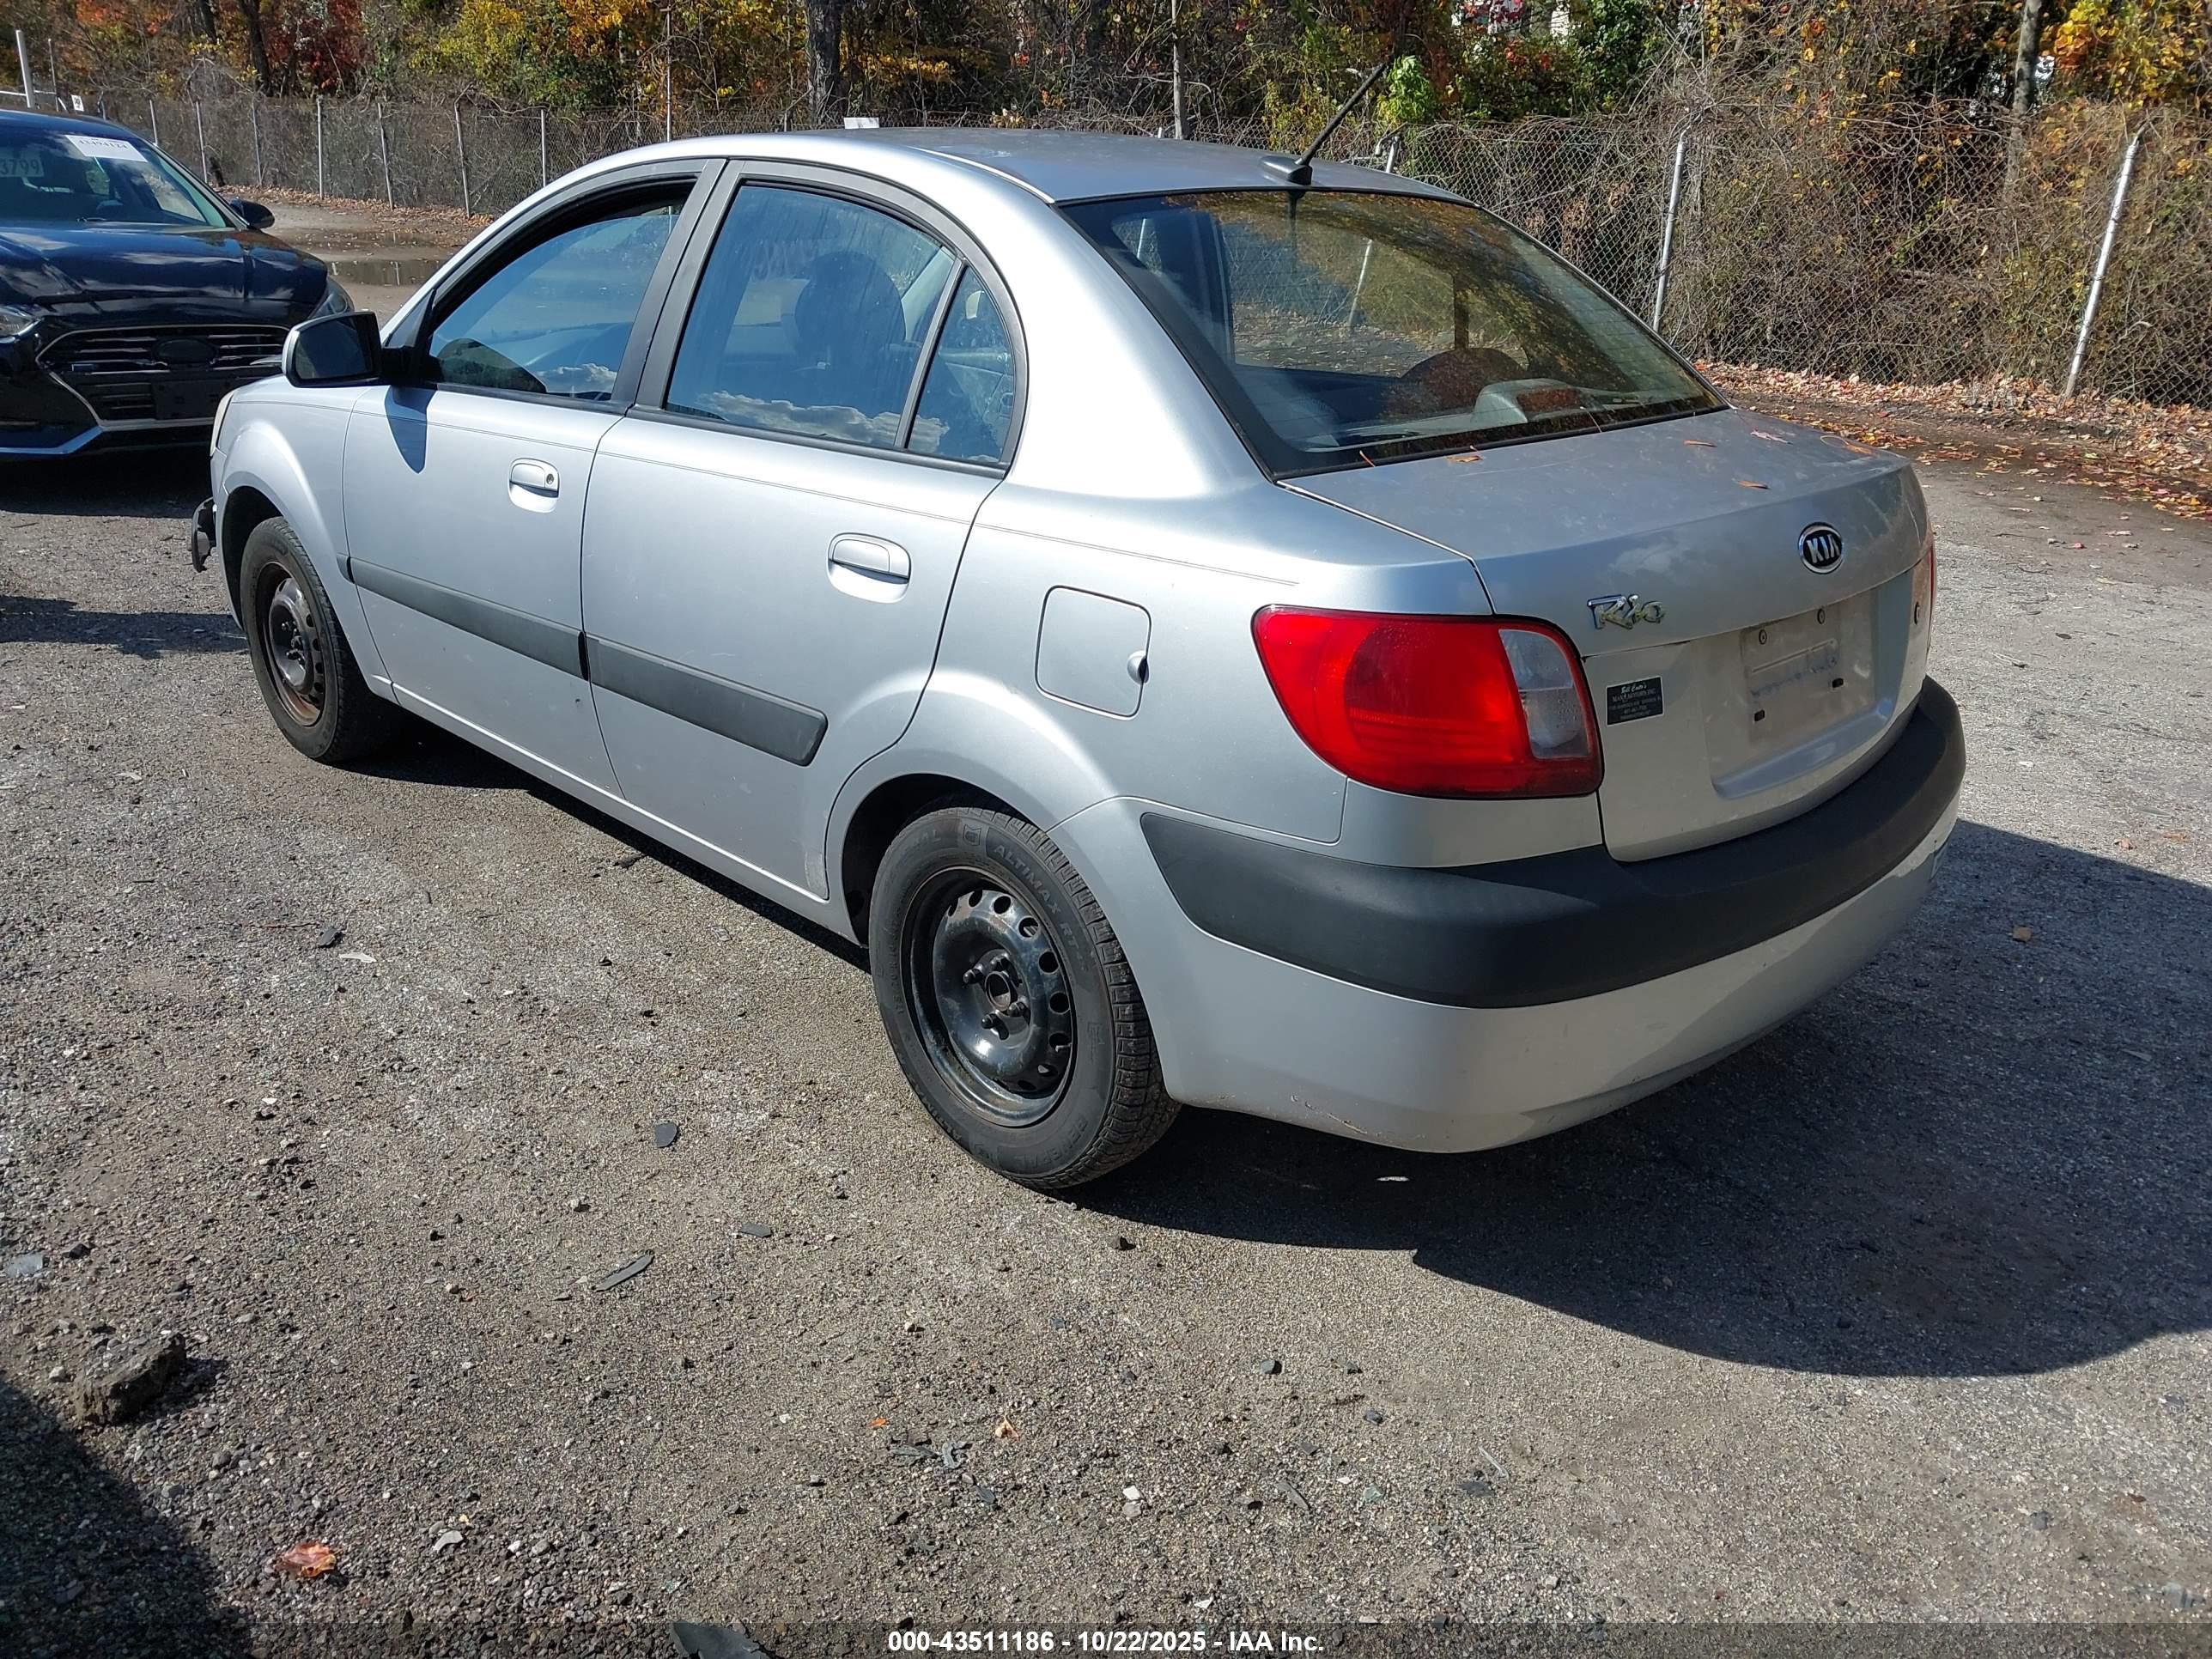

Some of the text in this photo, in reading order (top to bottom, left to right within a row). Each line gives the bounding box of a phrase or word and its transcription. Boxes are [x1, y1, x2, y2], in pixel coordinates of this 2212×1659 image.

[1806, 534, 1842, 563] KIA
[1587, 593, 1666, 629] Rio
[993, 845, 1062, 915] ALTIMAX
